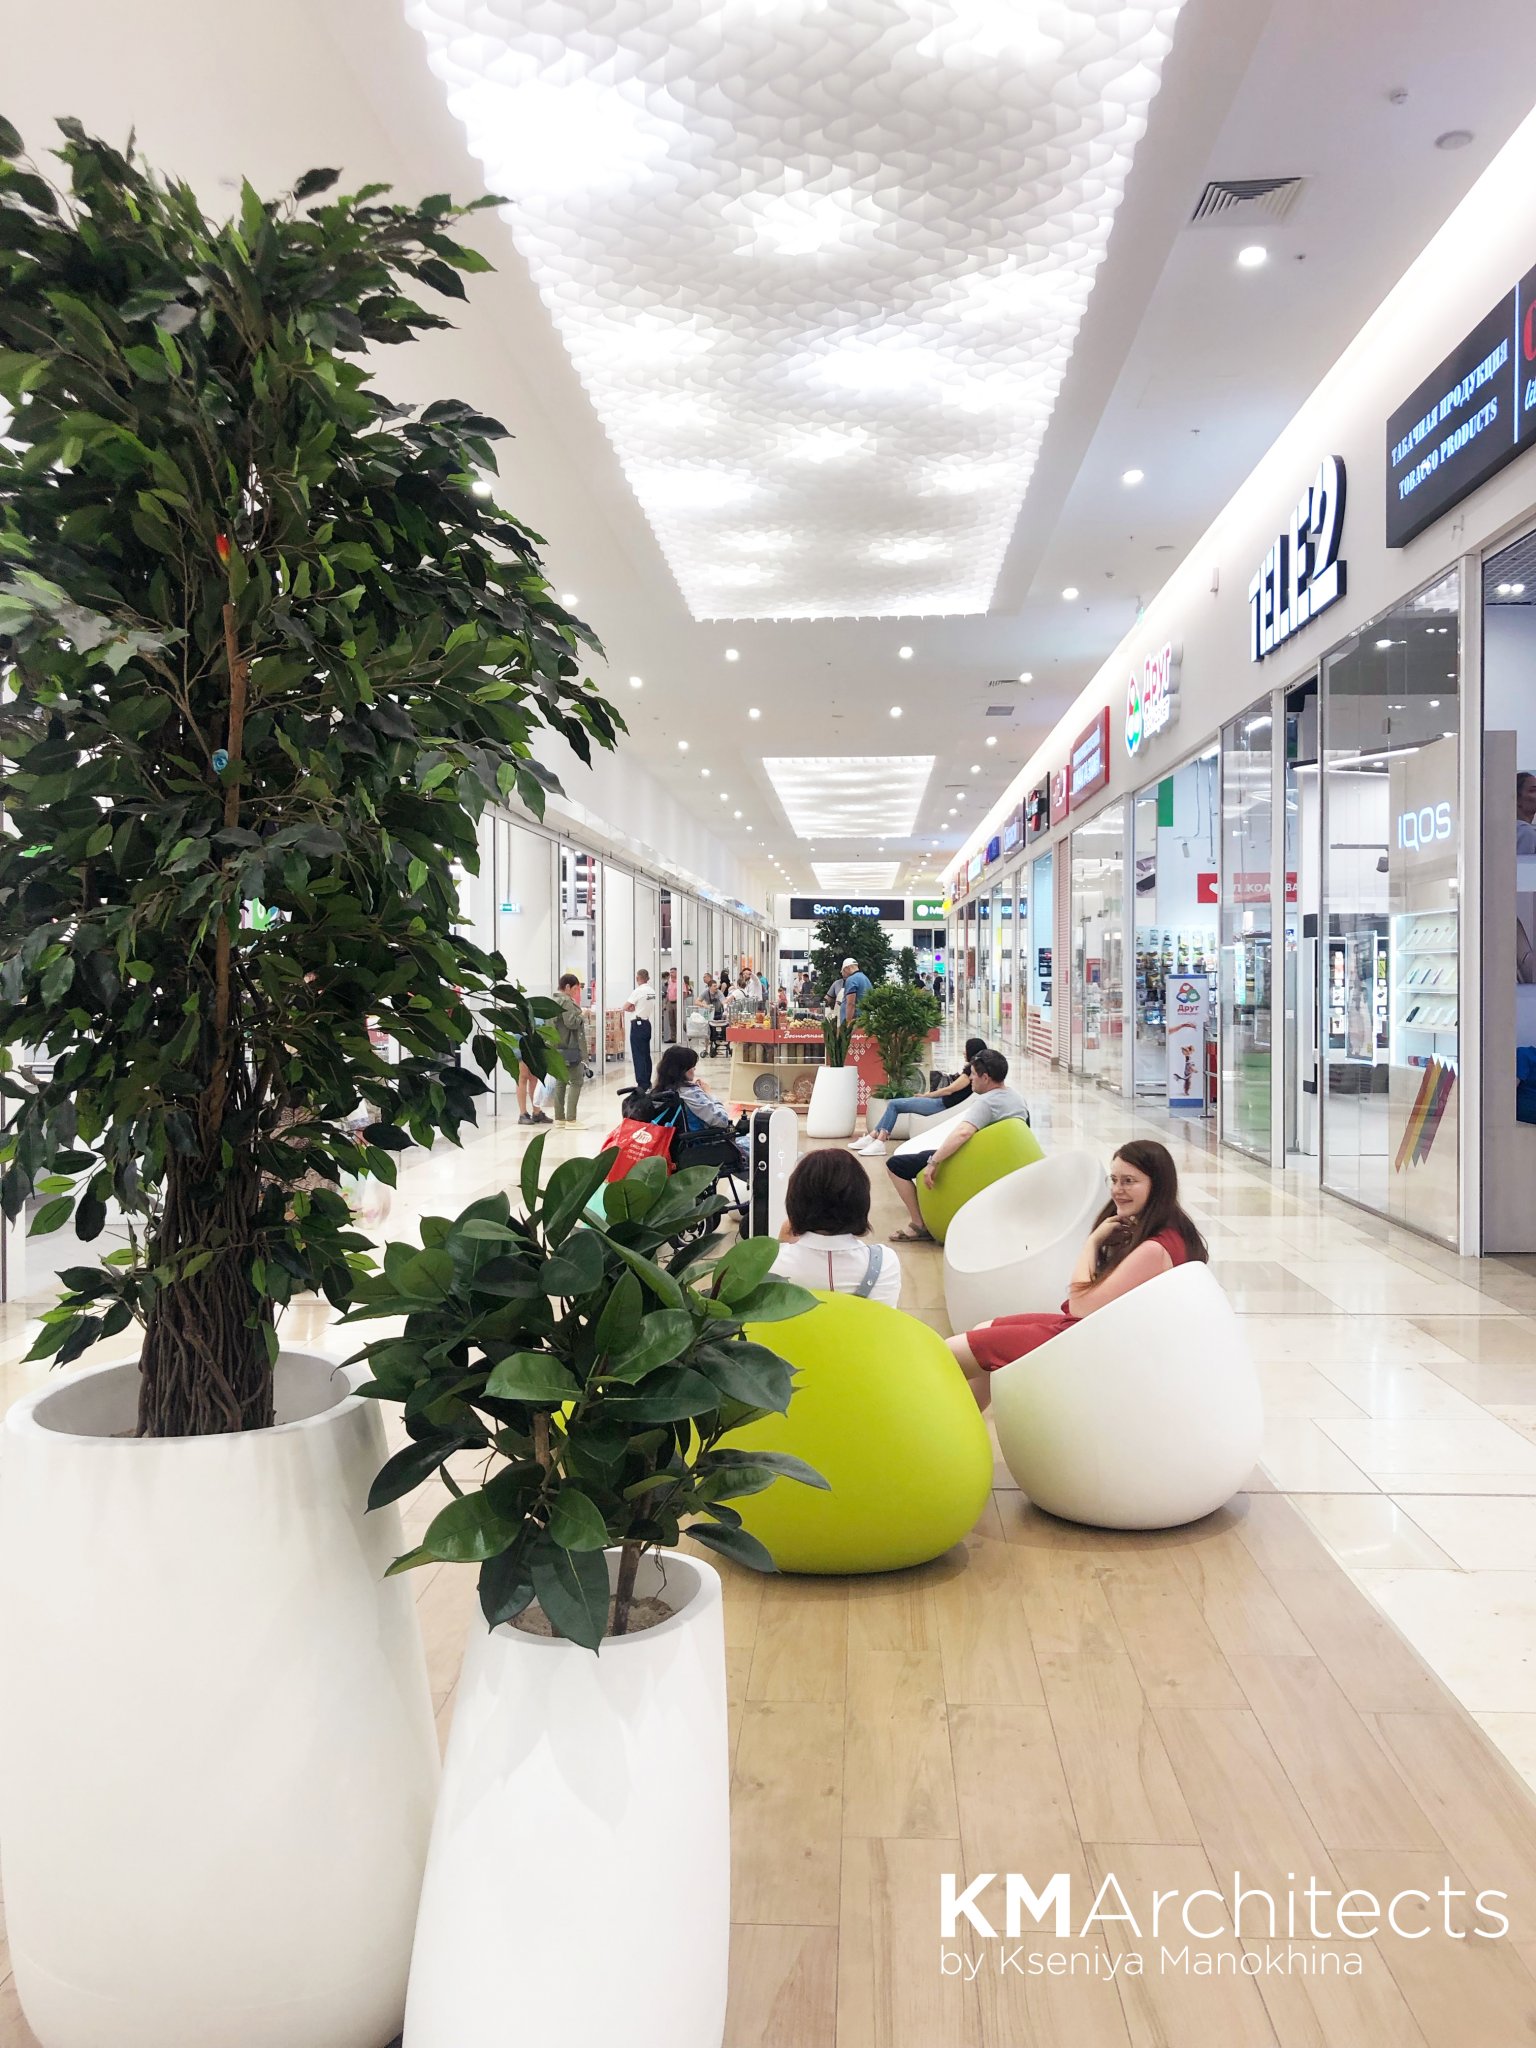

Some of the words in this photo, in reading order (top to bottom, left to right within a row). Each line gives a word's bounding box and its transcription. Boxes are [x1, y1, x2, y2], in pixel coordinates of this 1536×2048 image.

[1391, 405, 1439, 468] ТАБАЧНАЯ
[1440, 337, 1509, 421] ПРОДУКЦИЯ
[1440, 396, 1498, 464] PRODUCTS
[1249, 454, 1347, 663] TELE2
[1398, 801, 1451, 852] IQOS
[1177, 1004, 1200, 1013] Друг
